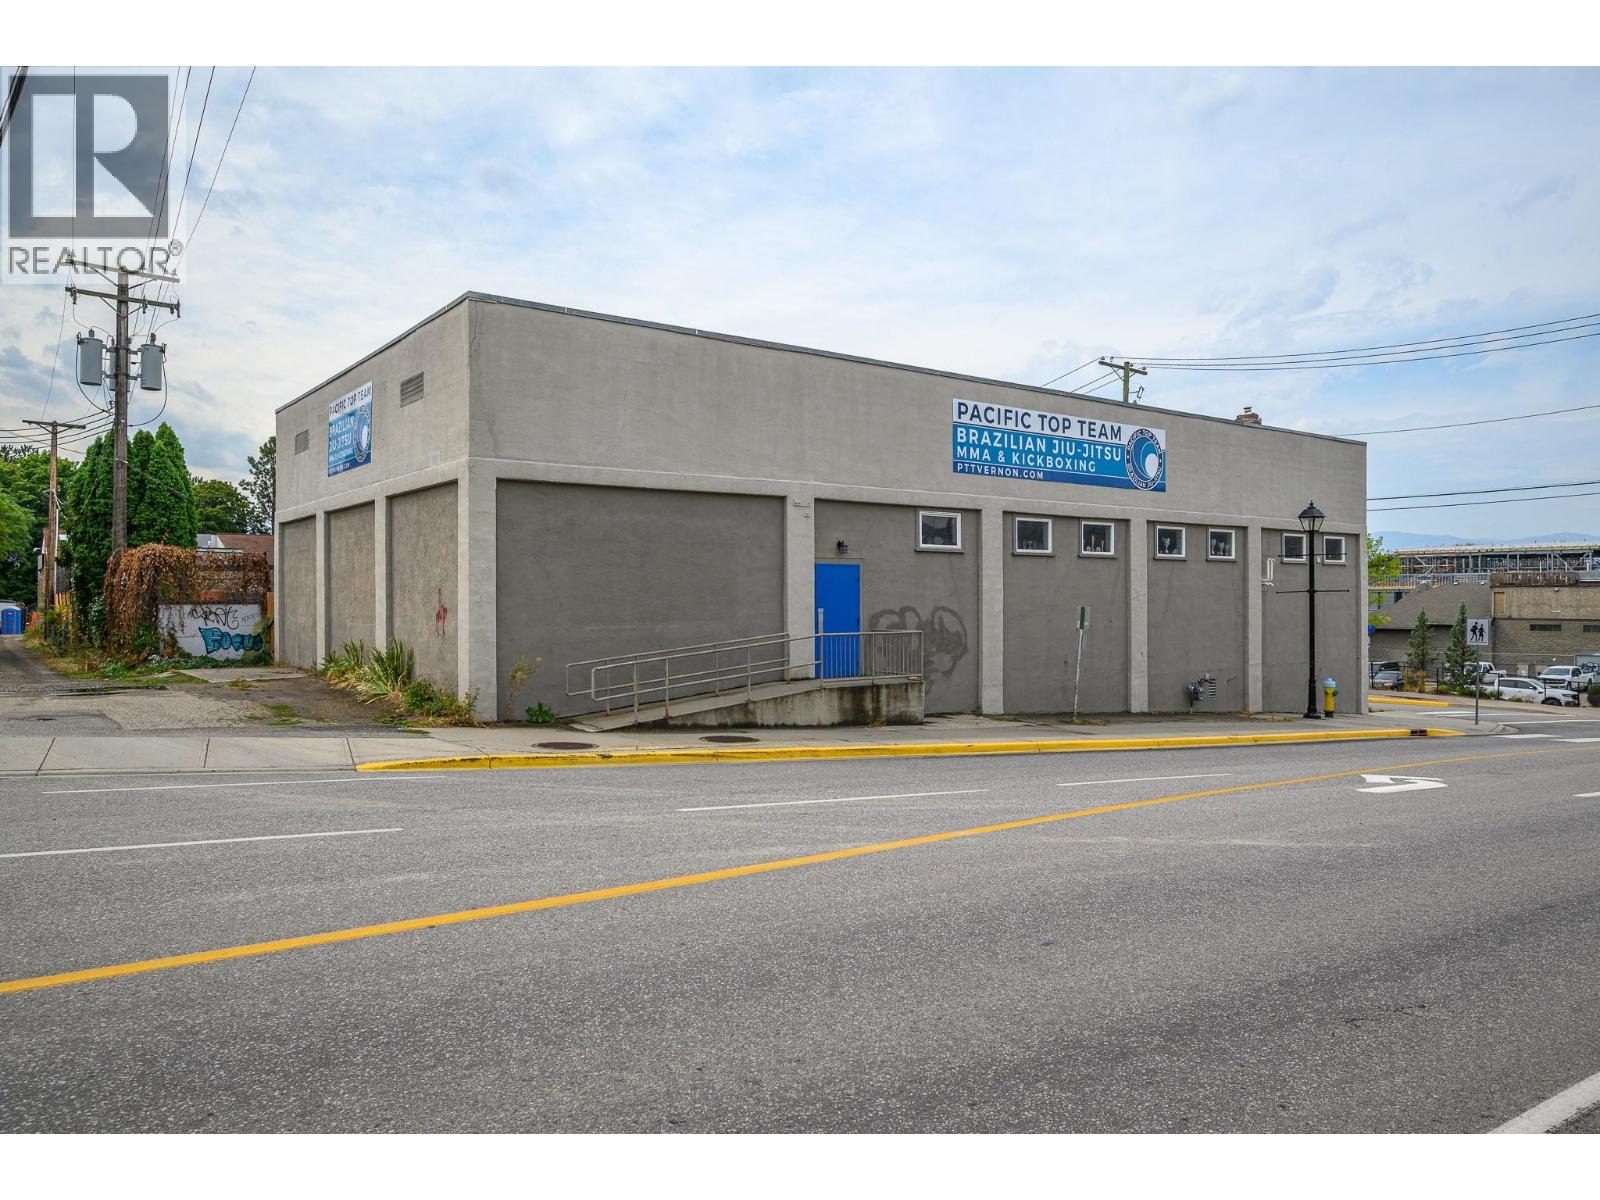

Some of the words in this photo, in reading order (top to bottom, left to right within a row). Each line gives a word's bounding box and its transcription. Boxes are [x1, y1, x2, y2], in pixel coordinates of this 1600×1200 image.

[957, 402, 1032, 429] PACIFIC
[1038, 414, 1071, 434] TOP
[1077, 420, 1122, 442] TEAM
[957, 427, 1046, 453] BRAZILIAN
[1053, 440, 1122, 462] JIU-JITSU
[957, 445, 991, 461] MMA
[997, 451, 1006, 463] &
[1012, 451, 1096, 472] KICKBOXING
[957, 463, 1044, 480] PTTVERNON.COM
